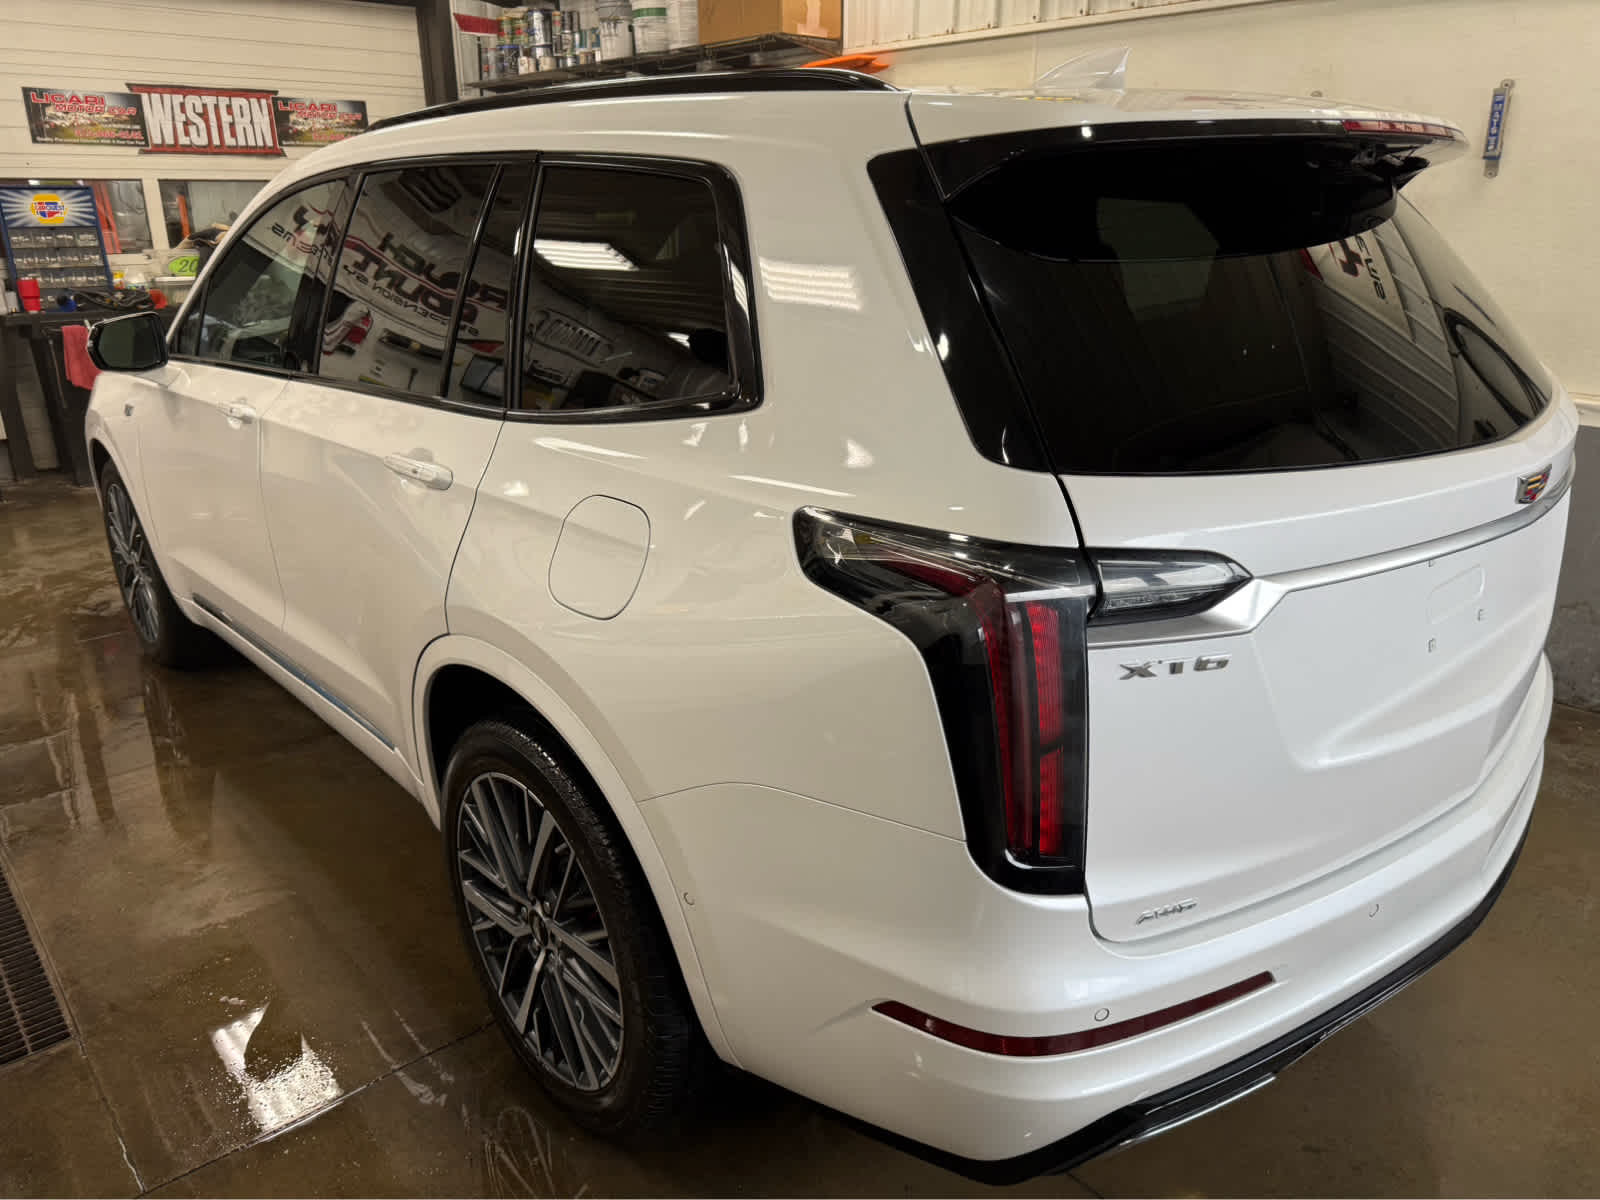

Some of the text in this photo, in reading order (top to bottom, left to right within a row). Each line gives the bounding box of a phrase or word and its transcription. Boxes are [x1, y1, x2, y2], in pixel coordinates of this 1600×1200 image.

[31, 92, 106, 105] LICARI
[55, 103, 105, 114] MOTOR
[278, 101, 338, 113] LICARI
[140, 93, 275, 148] WESTERN
[1119, 654, 1231, 681] XT6
